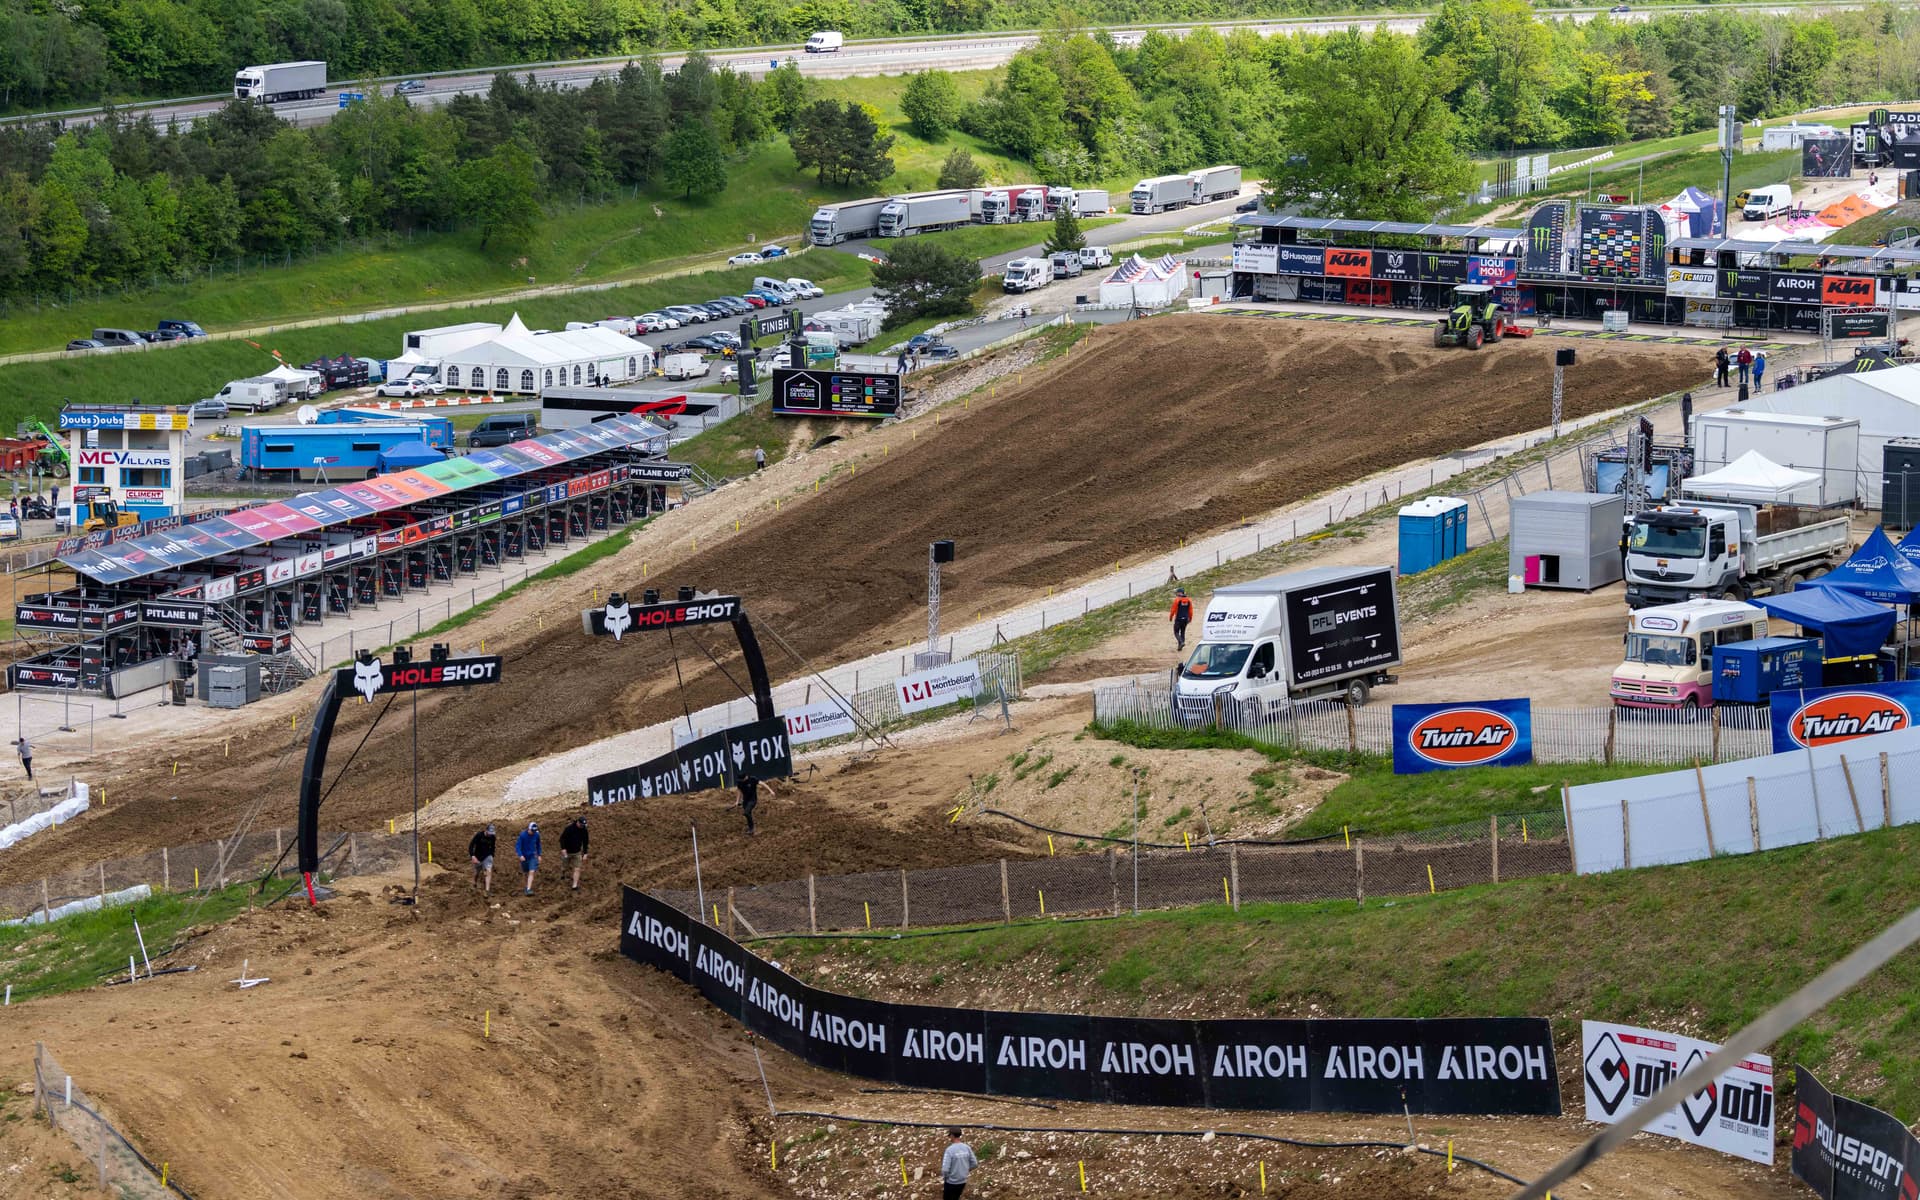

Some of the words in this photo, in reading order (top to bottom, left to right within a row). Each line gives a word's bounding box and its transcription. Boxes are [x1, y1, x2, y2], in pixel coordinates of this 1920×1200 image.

[1289, 251, 1322, 261] Husqvarna
[1329, 252, 1368, 267] KTM
[1480, 258, 1504, 267] LIQUI
[1479, 267, 1505, 276] MOLY
[1776, 279, 1815, 289] AIROH
[1827, 279, 1870, 295] KTM
[761, 318, 789, 334] FINISH
[630, 468, 663, 478] PITLANE
[663, 470, 681, 479] OUT
[116, 525, 142, 536] LIQUI
[146, 608, 187, 620] PITLANE
[187, 610, 199, 620] IN
[637, 602, 735, 627] HOLESHOT
[1312, 616, 1332, 630] PFL
[1335, 605, 1377, 624] EVENTS
[391, 662, 496, 687] HOLESHOT
[1421, 727, 1474, 747] Twin
[1474, 725, 1511, 745] Air
[1802, 714, 1860, 737] Twin
[1860, 711, 1901, 733] Air
[748, 735, 785, 765] FOX
[693, 749, 727, 783] FOX
[655, 768, 682, 797] FOX
[627, 910, 690, 962] AIROH
[695, 944, 745, 997] AIROH
[748, 977, 804, 1032] AIROH
[810, 1010, 886, 1054] AIROH
[902, 1027, 984, 1064] AIROH
[996, 1035, 1086, 1071] AIROH
[1100, 1041, 1196, 1077] AIROH
[1212, 1045, 1307, 1078] AIROH
[1323, 1045, 1425, 1080] AIROH
[1437, 1045, 1548, 1081] AIROH
[1815, 1116, 1904, 1187] POLISPORT
[1865, 1173, 1886, 1193] PARTS
